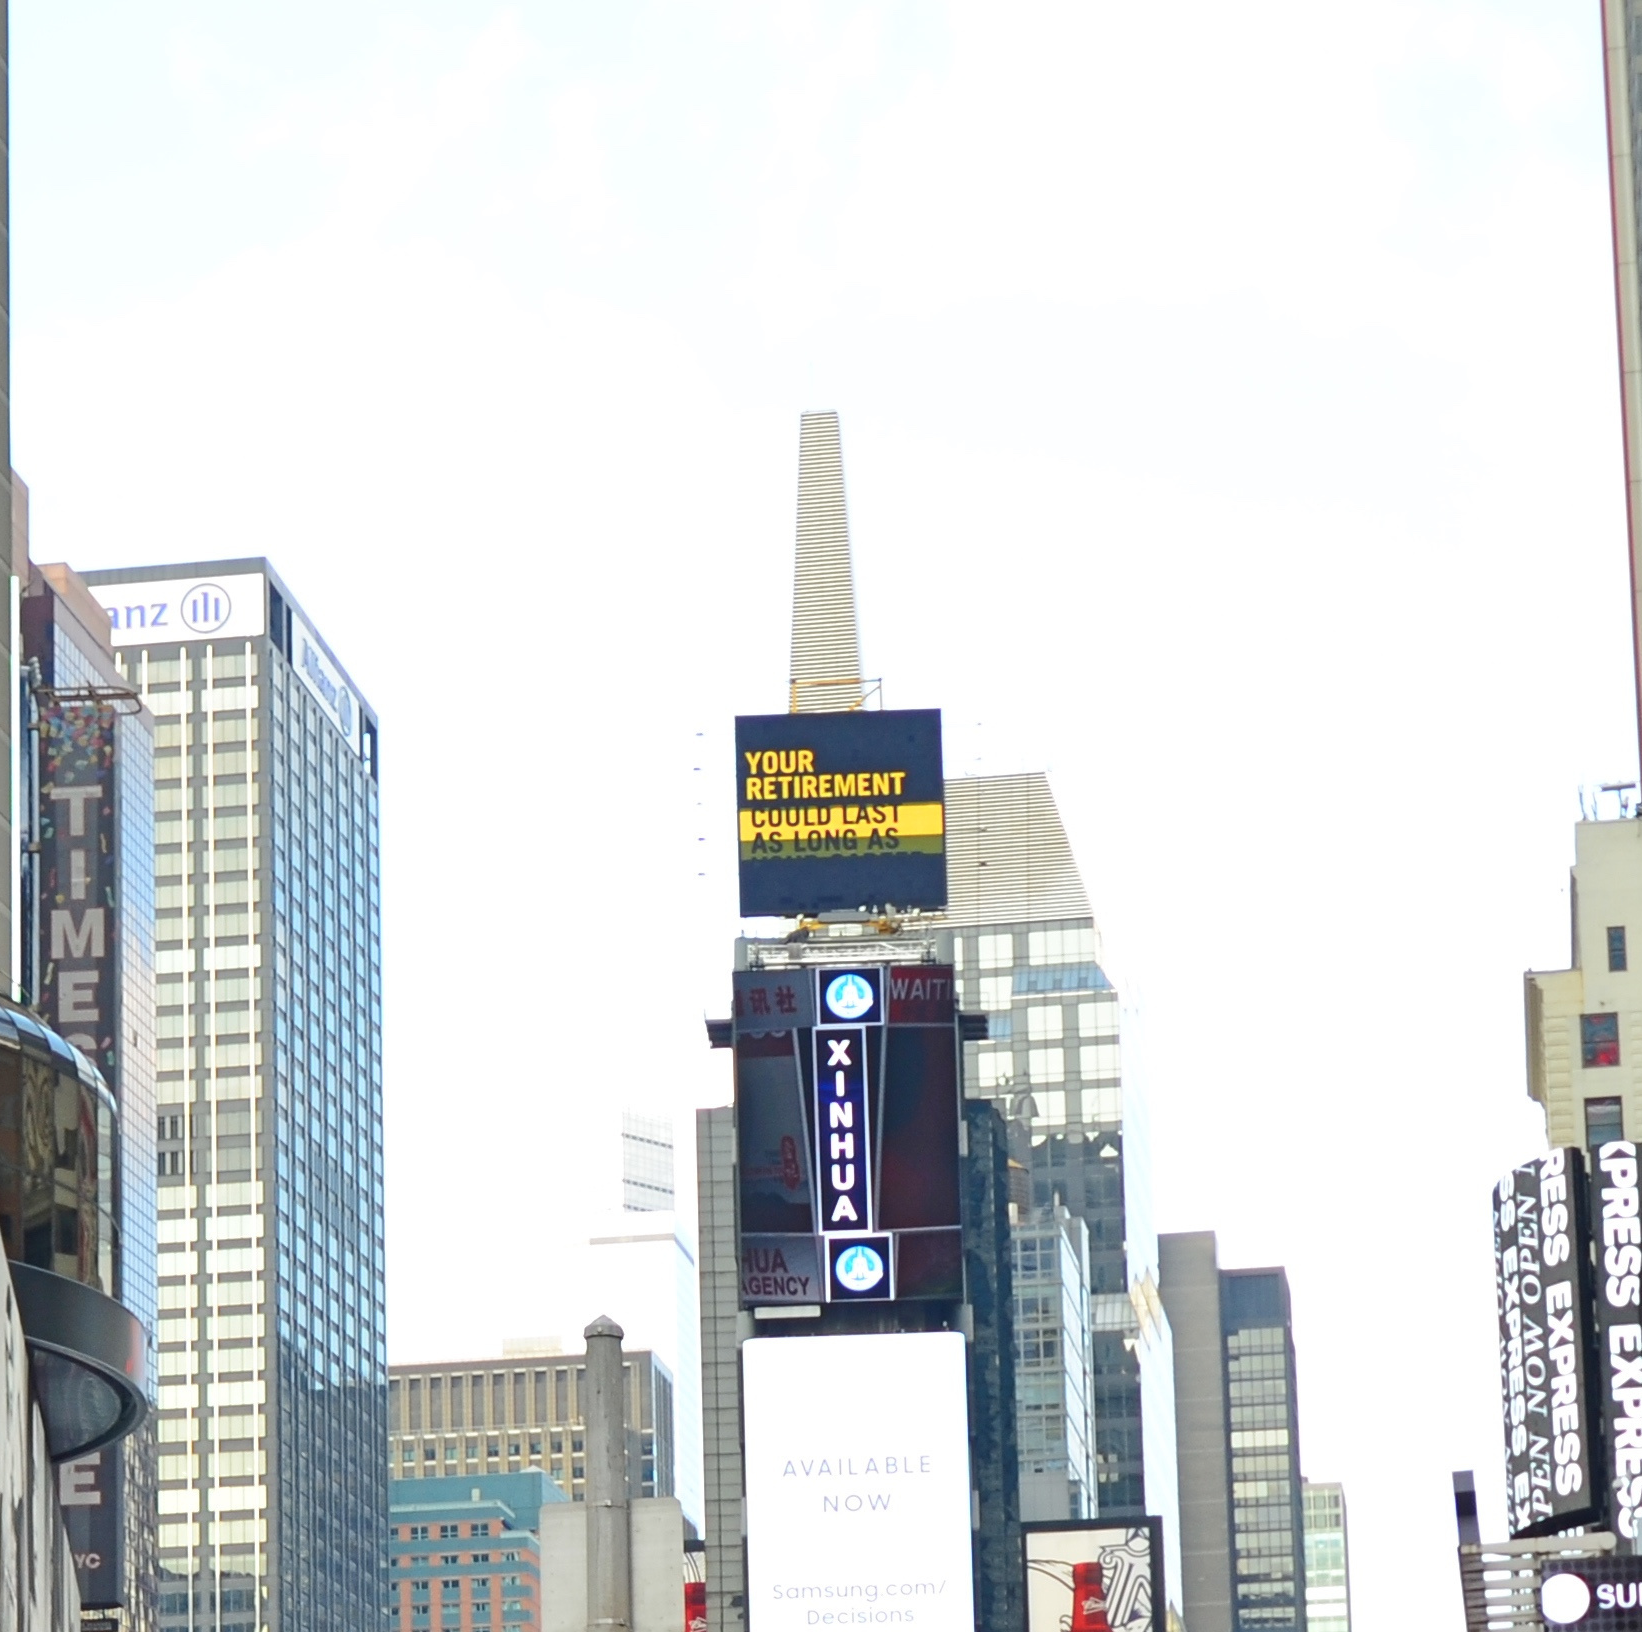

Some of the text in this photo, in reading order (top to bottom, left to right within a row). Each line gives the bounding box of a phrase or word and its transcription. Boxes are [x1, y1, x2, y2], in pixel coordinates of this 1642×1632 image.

[744, 750, 814, 775] YOUR
[745, 771, 907, 800] RETIREMENT
[751, 804, 900, 829] COULD LAST
[751, 827, 899, 855] AS LONG AS
[826, 1038, 859, 1223] XINHUA
[1517, 1194, 1543, 1306] OPEN
[1524, 1314, 1548, 1417] NOW
[1545, 1280, 1583, 1497] EXPRESS
[783, 1455, 932, 1477] AVAILABLE
[823, 1494, 891, 1513] NOW
[773, 1580, 947, 1603] Samsung.com/
[807, 1606, 915, 1626] Decisions
